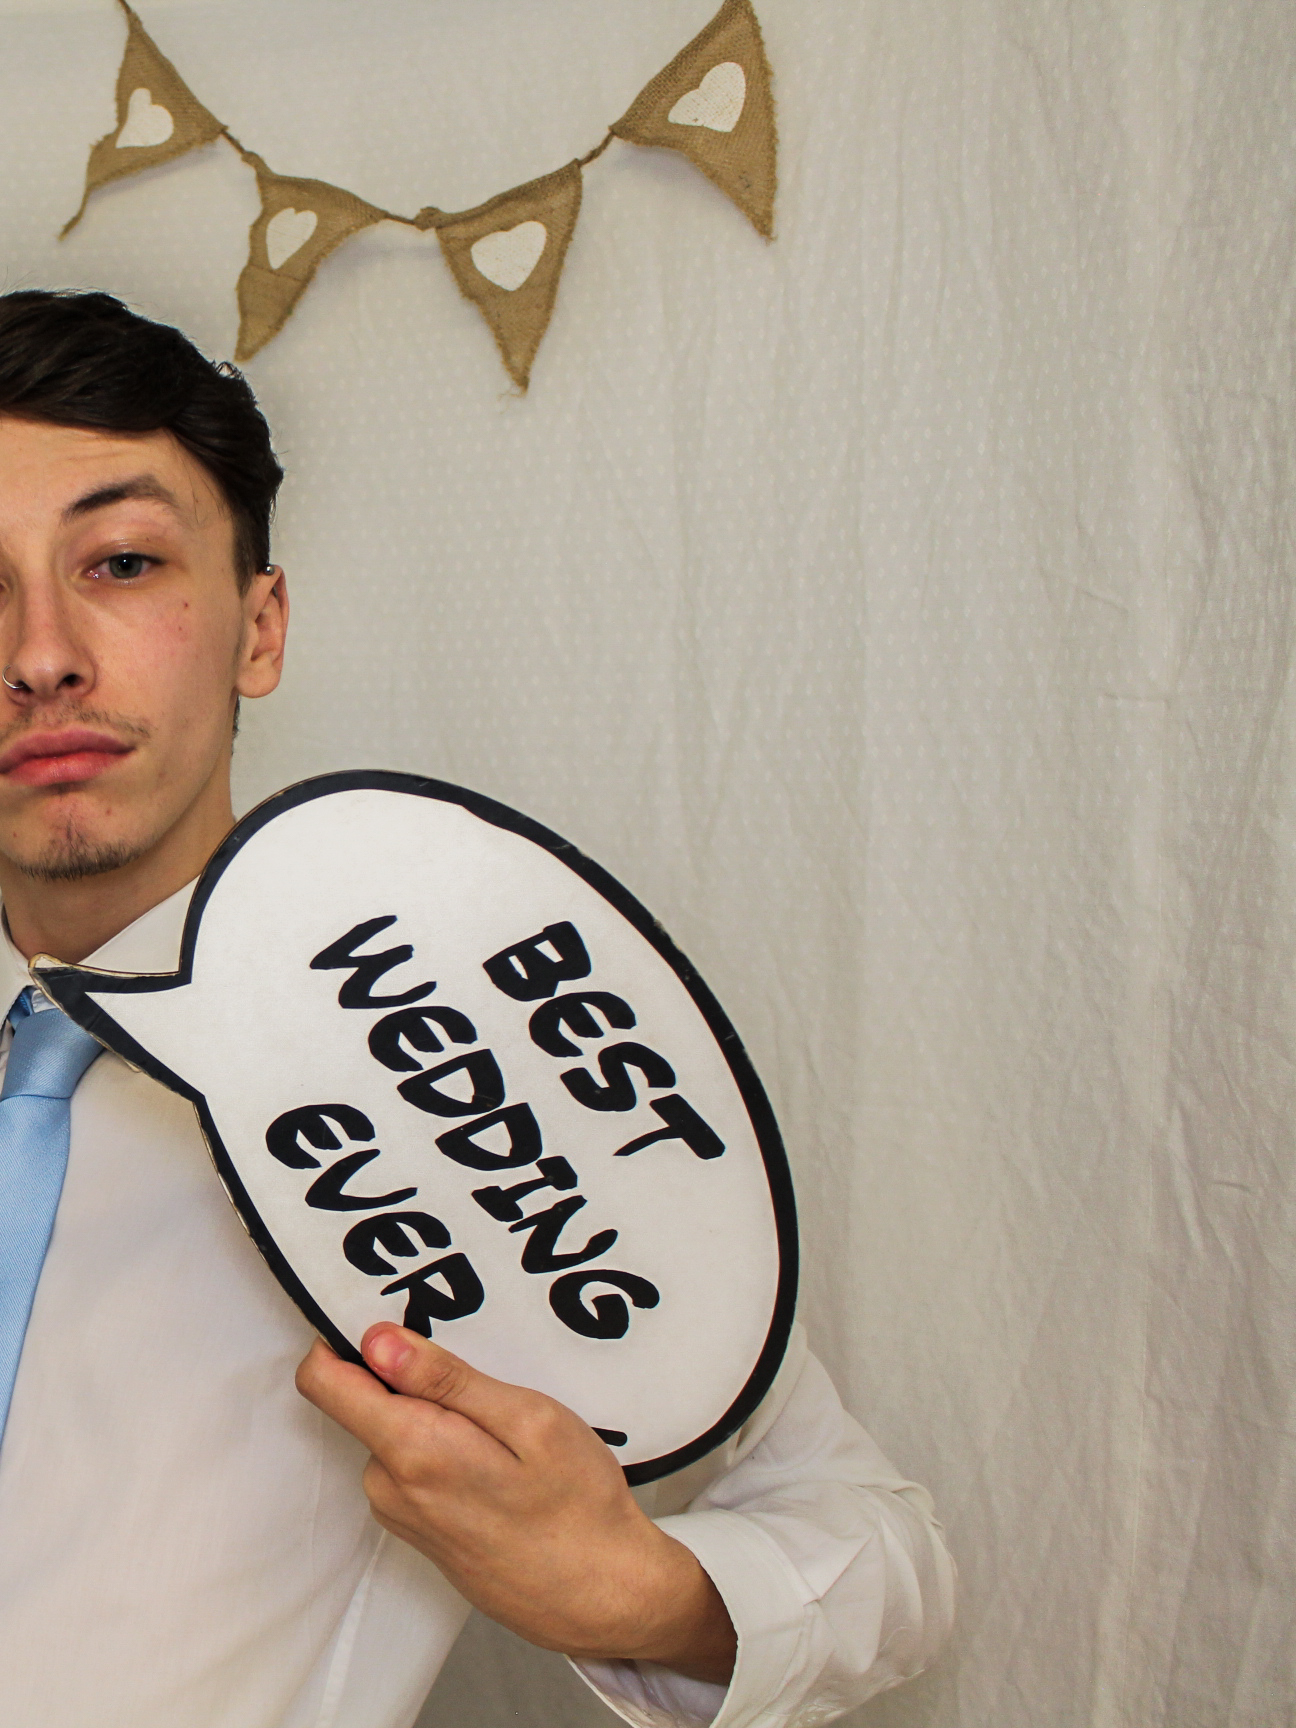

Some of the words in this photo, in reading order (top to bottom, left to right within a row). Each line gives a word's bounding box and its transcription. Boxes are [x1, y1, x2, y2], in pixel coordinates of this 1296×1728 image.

[309, 915, 660, 1340] WEDDING
[483, 920, 726, 1160] BEST
[265, 1103, 485, 1339] EVER
